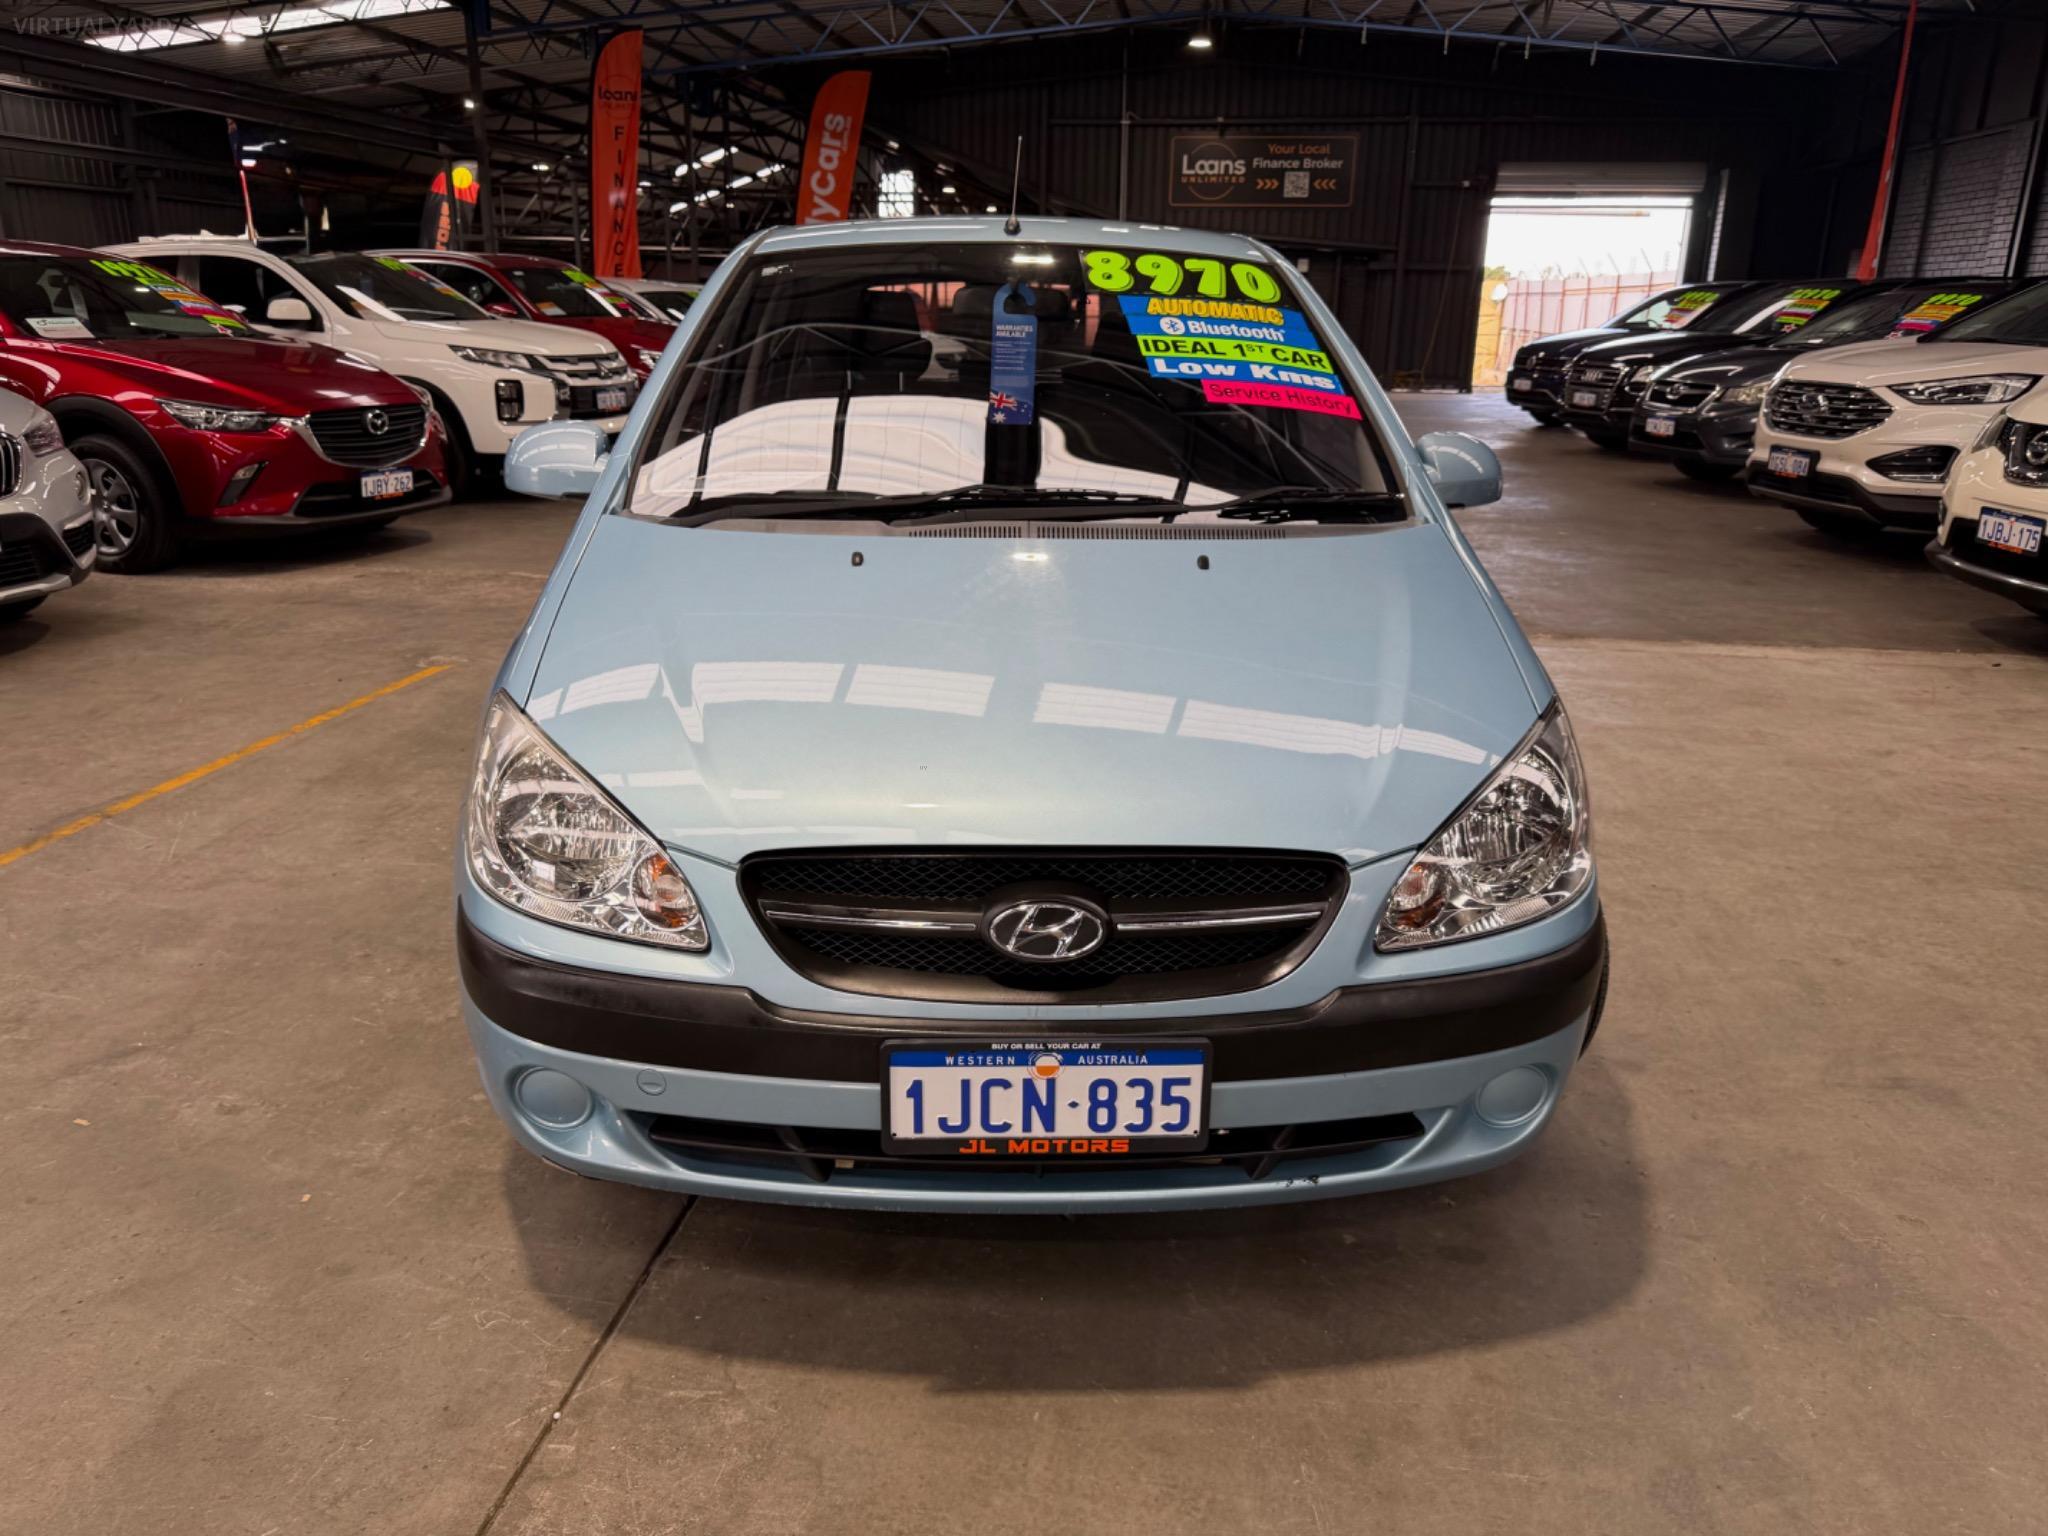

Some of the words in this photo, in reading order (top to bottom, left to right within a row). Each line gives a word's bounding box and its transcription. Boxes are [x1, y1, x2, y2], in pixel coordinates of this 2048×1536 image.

[1252, 157, 1300, 169] Finance
[1302, 157, 1345, 169] Broker
[1267, 143, 1297, 155] Your
[1298, 143, 1331, 155] Local
[1181, 154, 1247, 175] Loans
[613, 125, 626, 278] FINANCE
[1085, 250, 1281, 303] 8970
[1147, 297, 1285, 326] AUTOMATIC
[1142, 338, 1228, 357] IDEAL
[1271, 348, 1327, 370] CAR
[1154, 358, 1237, 378] Low
[1250, 364, 1337, 390] Kms
[1209, 384, 1282, 402] Service
[1288, 390, 1353, 414] History
[945, 1056, 1015, 1066] WESTERN
[1077, 1055, 1149, 1065] AUSTRALIA
[959, 1139, 997, 1154] JL
[1008, 1139, 1130, 1153] MOTORS
